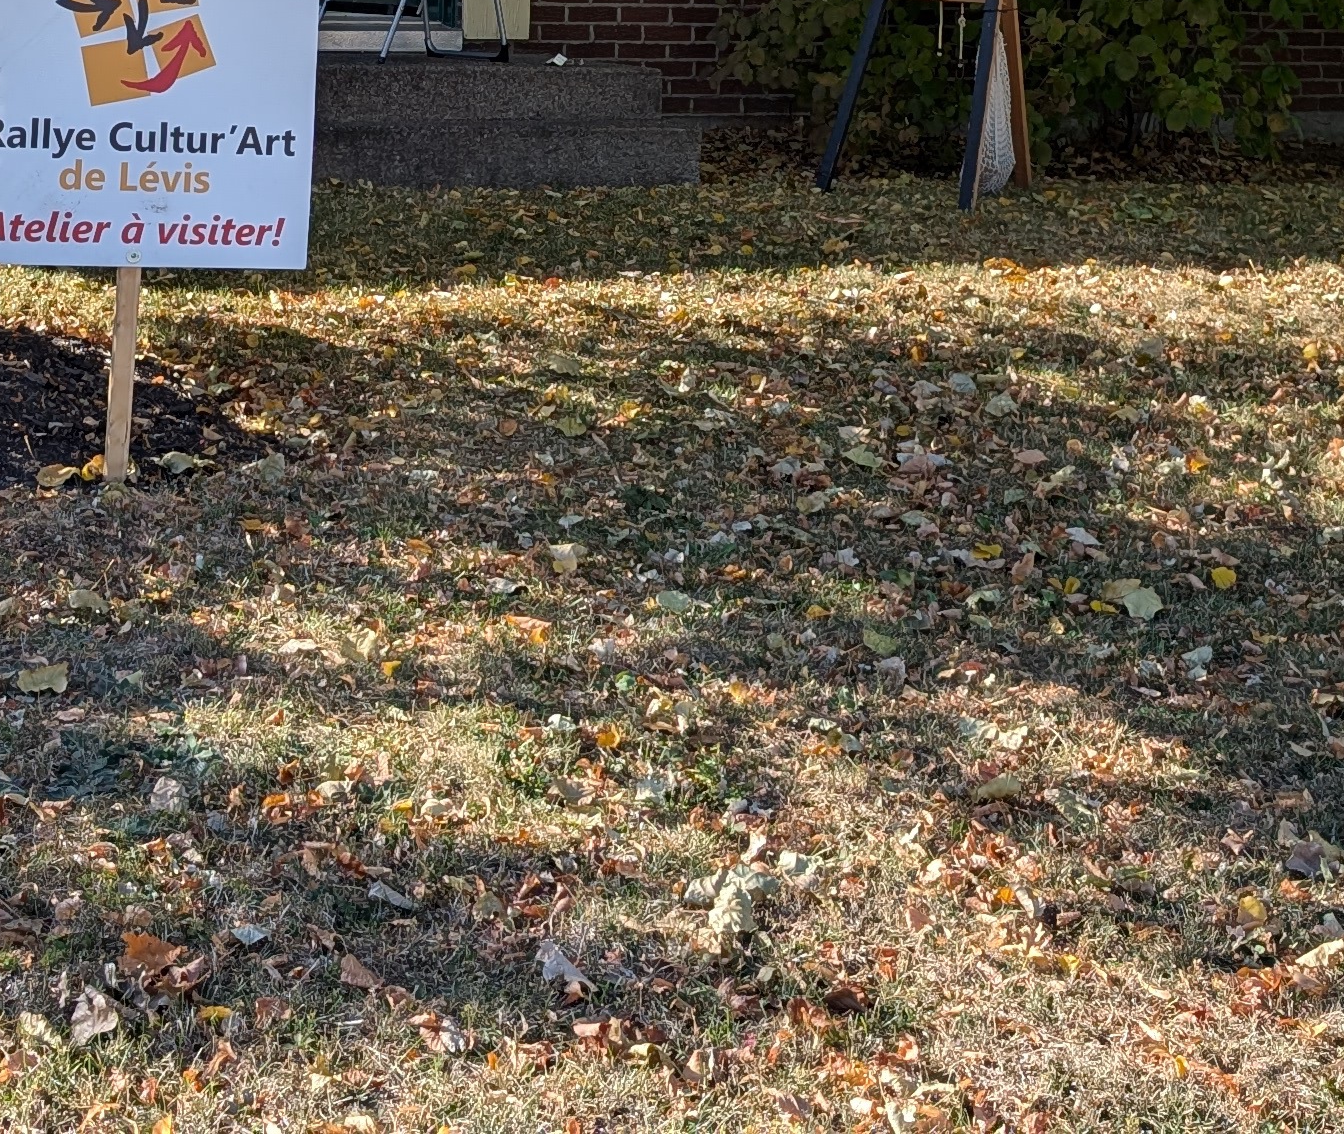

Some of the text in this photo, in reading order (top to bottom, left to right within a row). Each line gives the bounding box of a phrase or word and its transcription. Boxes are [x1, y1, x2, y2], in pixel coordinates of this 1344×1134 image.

[109, 121, 296, 157] Cultur'Art
[58, 159, 210, 194] de Lévis
[121, 212, 144, 245] à
[158, 214, 285, 247] visiter!
